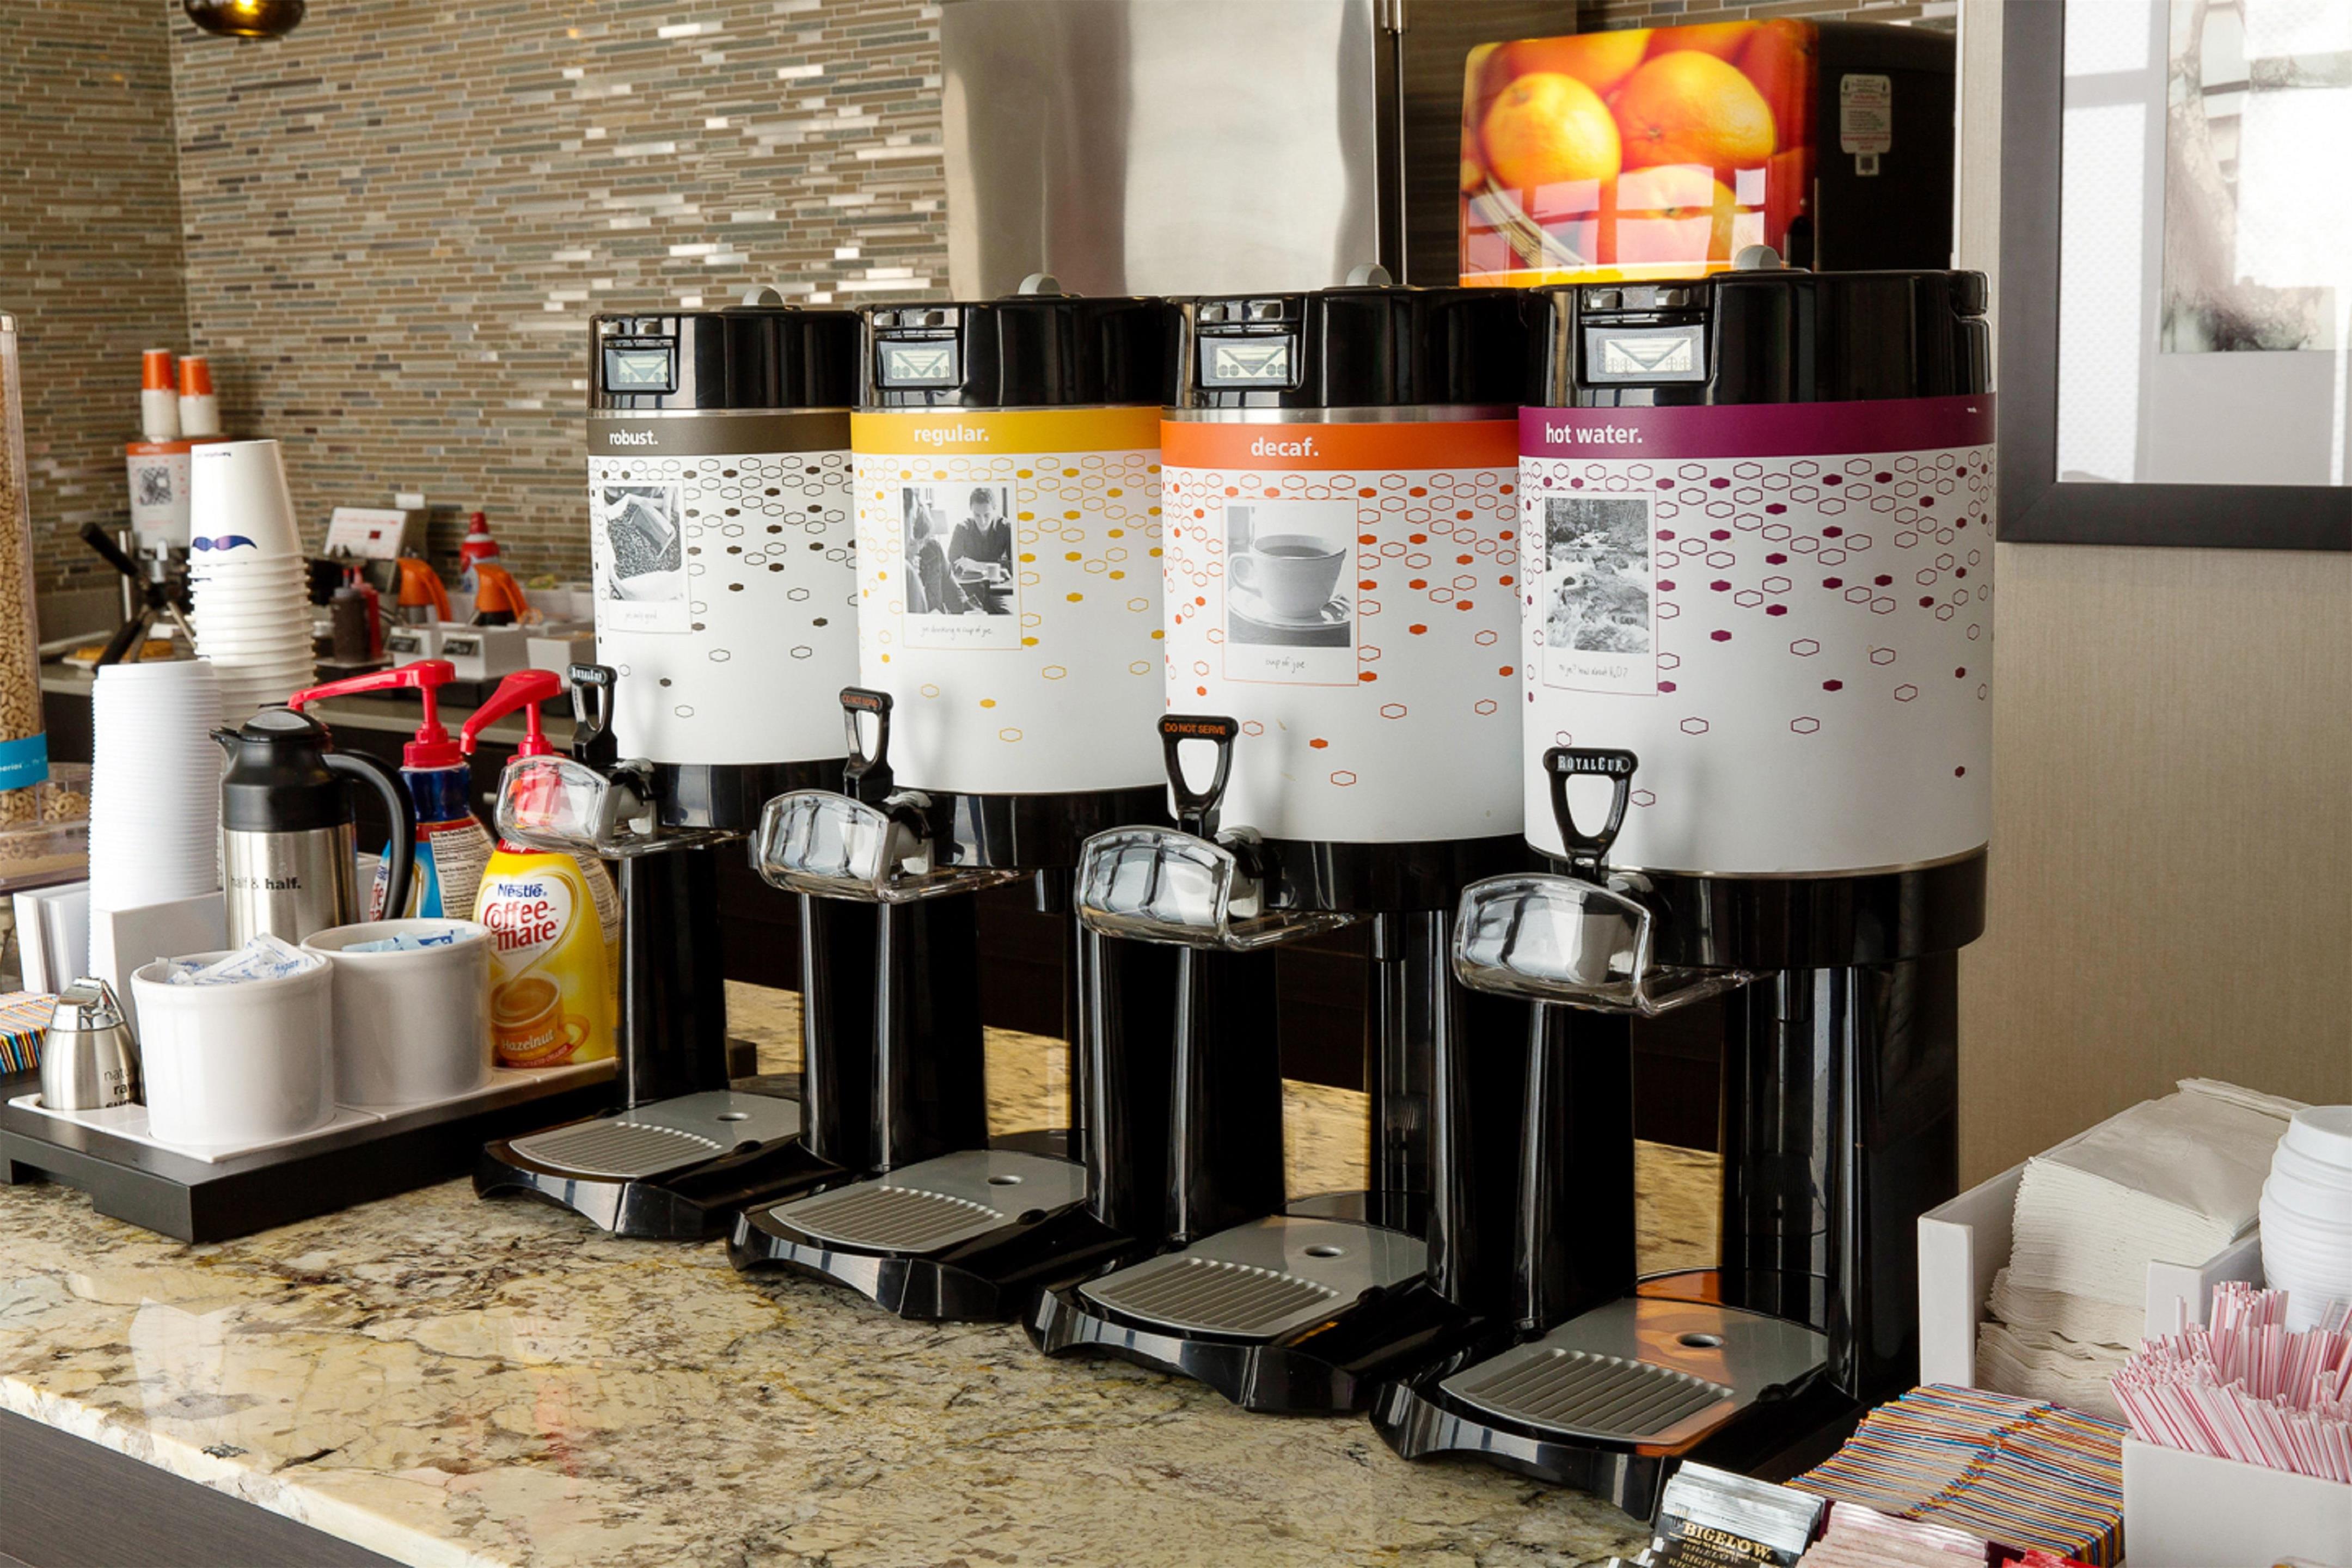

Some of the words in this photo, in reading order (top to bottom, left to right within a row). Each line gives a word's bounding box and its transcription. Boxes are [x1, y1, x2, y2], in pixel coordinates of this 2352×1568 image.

[609, 428, 658, 445] robust.
[914, 424, 989, 446] regular.
[1546, 421, 1572, 444] hot
[1576, 424, 1643, 444] water.
[1251, 436, 1319, 457] decaf.
[1291, 660, 1305, 674] joe
[1165, 722, 1178, 732] DO
[1179, 723, 1196, 733] NOT
[1198, 725, 1226, 735] SERVE
[250, 877, 259, 890] &
[265, 877, 302, 890] half.
[497, 920, 558, 951] mate
[501, 1028, 555, 1051] Hazelnut
